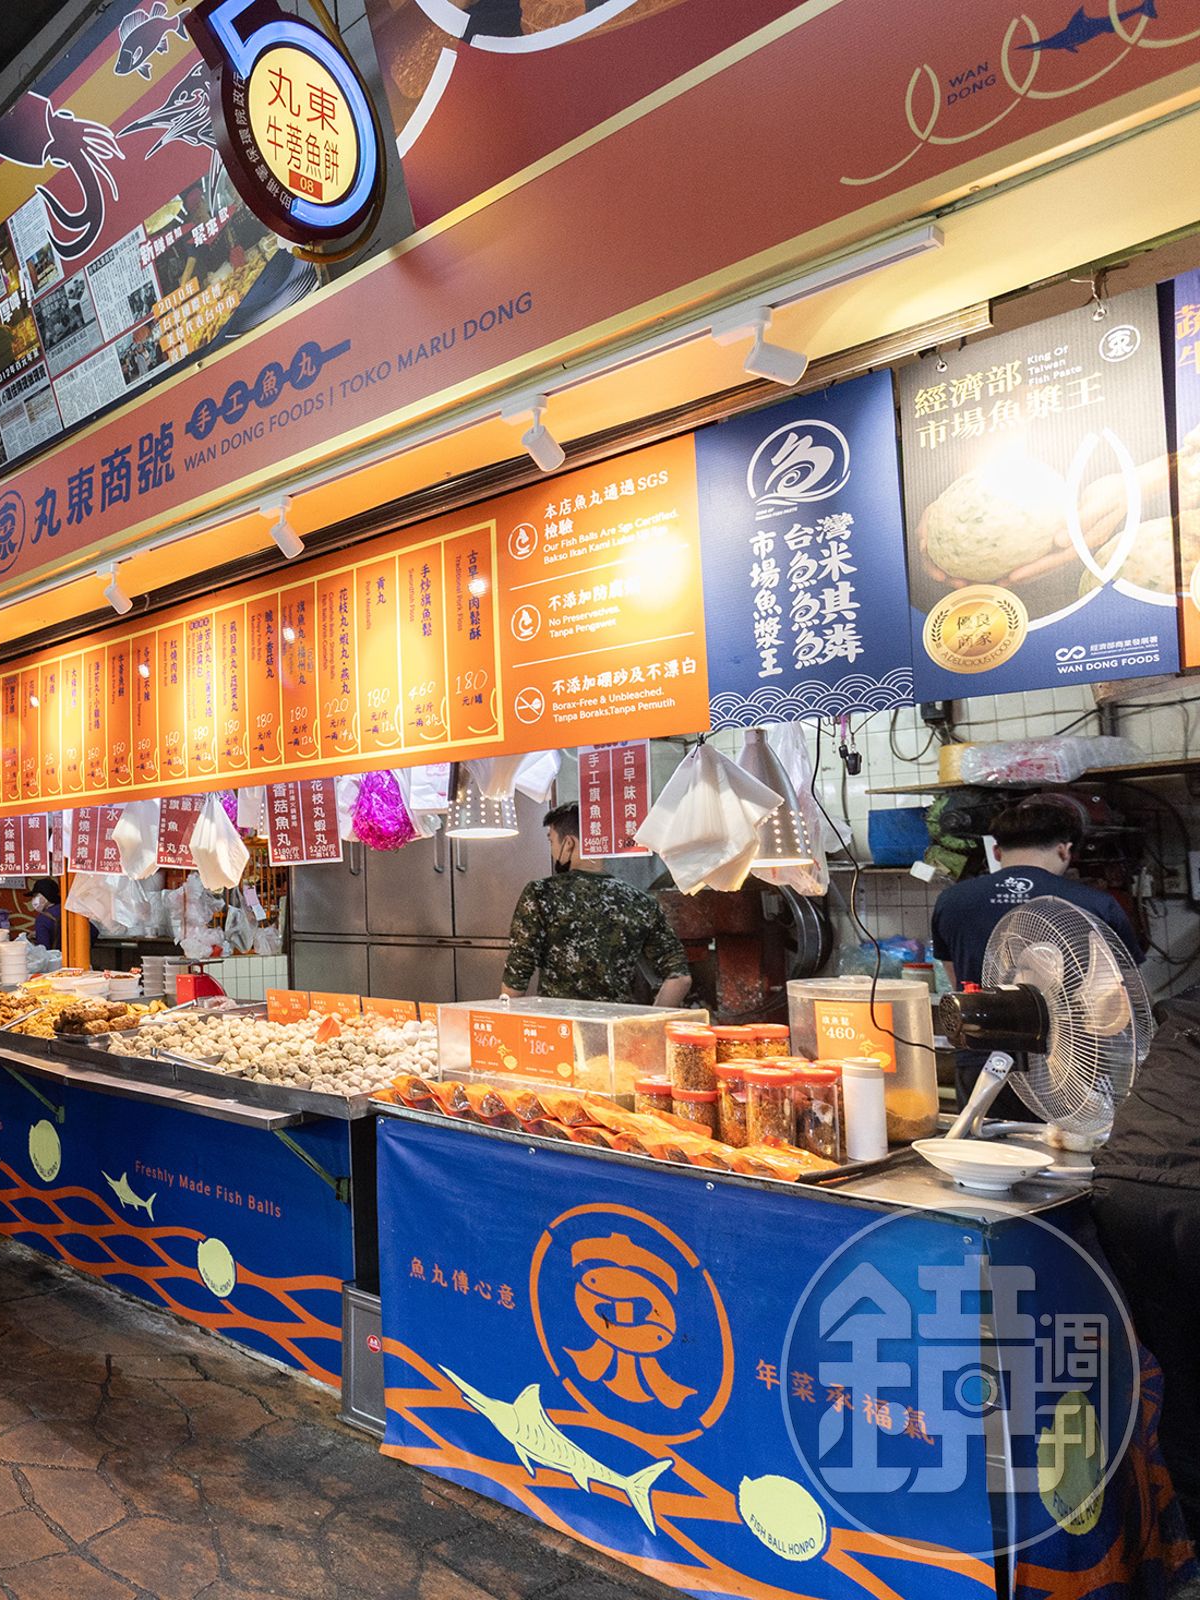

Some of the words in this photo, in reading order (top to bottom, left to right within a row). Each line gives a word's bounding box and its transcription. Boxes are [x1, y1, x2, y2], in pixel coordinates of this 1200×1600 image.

[948, 61, 990, 88] WAN
[268, 67, 339, 135] 丸東
[946, 74, 997, 106] DONG
[267, 115, 339, 185] 牛蒡魚餅
[300, 178, 314, 193] 08
[1027, 351, 1052, 364] King
[1053, 344, 1069, 355] Of
[1028, 359, 1066, 374] Taiwan
[184, 450, 216, 473] WAN
[220, 428, 264, 459] DONG
[269, 407, 324, 444] FOODS
[339, 360, 391, 401] TOKO
[397, 334, 458, 374] MARU
[464, 292, 533, 338] DONG
[196, 350, 319, 430] 手工魚丸
[915, 360, 1023, 418] 經濟部
[1029, 373, 1050, 385] Fish
[1053, 365, 1082, 380] Paste
[916, 372, 1105, 450] 市場魚漿王
[31, 420, 175, 544] 丸東商號
[543, 542, 559, 553] Our
[561, 537, 577, 549] Fish
[579, 532, 598, 543] Balls
[600, 527, 616, 538] Are
[544, 518, 574, 540] 檢驗
[544, 552, 568, 564] Bakso
[570, 547, 587, 558] Ikan
[589, 540, 610, 552] Kami
[376, 576, 386, 605] 貢丸
[467, 550, 482, 640] 古早肉鬆酥
[749, 530, 785, 678] 市場魚漿王
[549, 617, 561, 627] No
[550, 627, 574, 638] Tanpa
[552, 656, 697, 695] 不添加硼砂及不漂白
[1057, 664, 1083, 674] WAN
[1086, 659, 1118, 671] DONG
[1121, 653, 1160, 666] FOODS
[408, 680, 435, 702] 460
[456, 668, 488, 695] 180
[324, 697, 349, 718] 220
[367, 687, 390, 709] 180
[553, 697, 598, 711] Borax-Free
[600, 695, 606, 704] &
[609, 687, 664, 703] Unbleached.
[553, 712, 577, 723] Tanpa
[638, 698, 675, 712] Pemutih
[224, 719, 239, 736] 180
[256, 712, 273, 728] 180
[290, 706, 308, 723] 180
[588, 753, 601, 836] 手工旗魚鬆
[623, 750, 637, 835] 古早味肉鬆
[273, 783, 291, 847] 香菇魚丸
[310, 780, 327, 845] 花枝丸蝦丸
[4, 817, 15, 864] 大條雞捲
[77, 807, 91, 858] 紅燒肉捲
[135, 1160, 174, 1187] Freshly
[179, 1174, 211, 1196] Made
[216, 1185, 242, 1206] Fish
[248, 1195, 281, 1218] Balls
[409, 1256, 516, 1310] 魚丸傳心意
[755, 1359, 934, 1446] 年菜承福氣
[749, 1513, 768, 1540] FISH
[767, 1531, 787, 1555] BALL
[787, 1536, 817, 1556] HONPO
